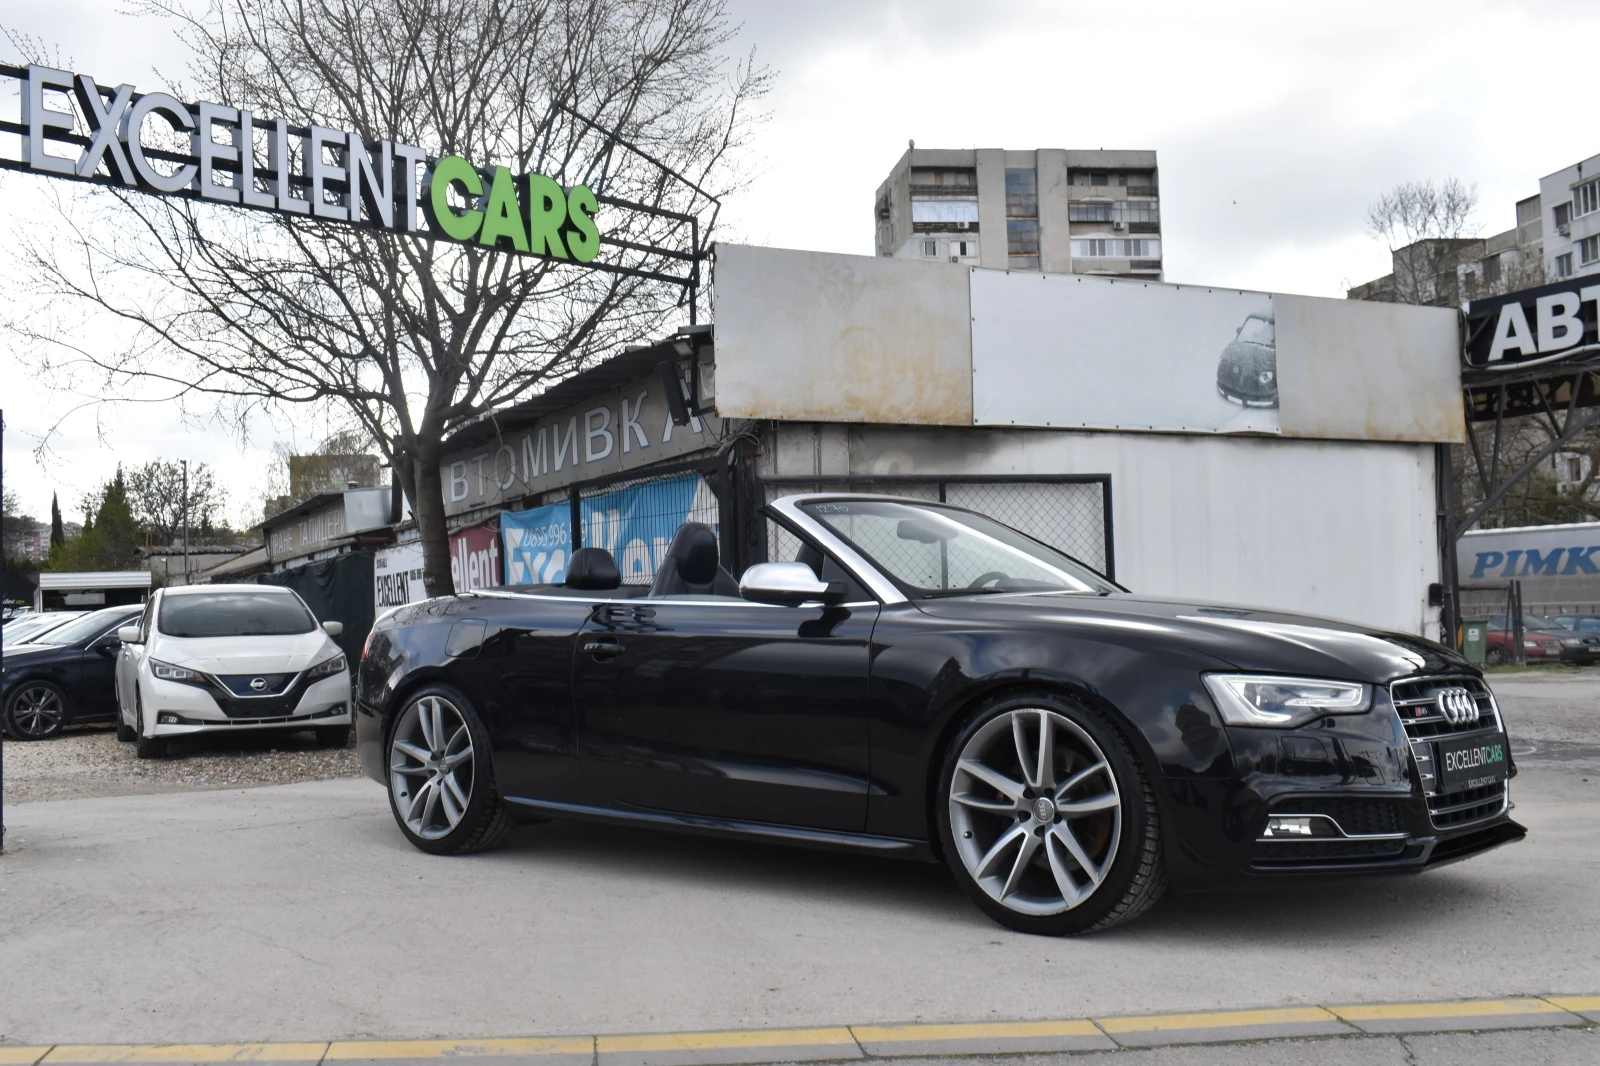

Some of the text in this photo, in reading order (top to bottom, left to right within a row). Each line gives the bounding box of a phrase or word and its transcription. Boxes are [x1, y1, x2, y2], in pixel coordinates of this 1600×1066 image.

[24, 64, 598, 263] EXCELLENT CARS
[443, 376, 704, 505] ВТОМИВКА
[270, 526, 293, 557] ПРАНЕ
[548, 522, 567, 546] 996
[376, 570, 410, 606] EXCELLENT
[451, 537, 499, 593] ellent
